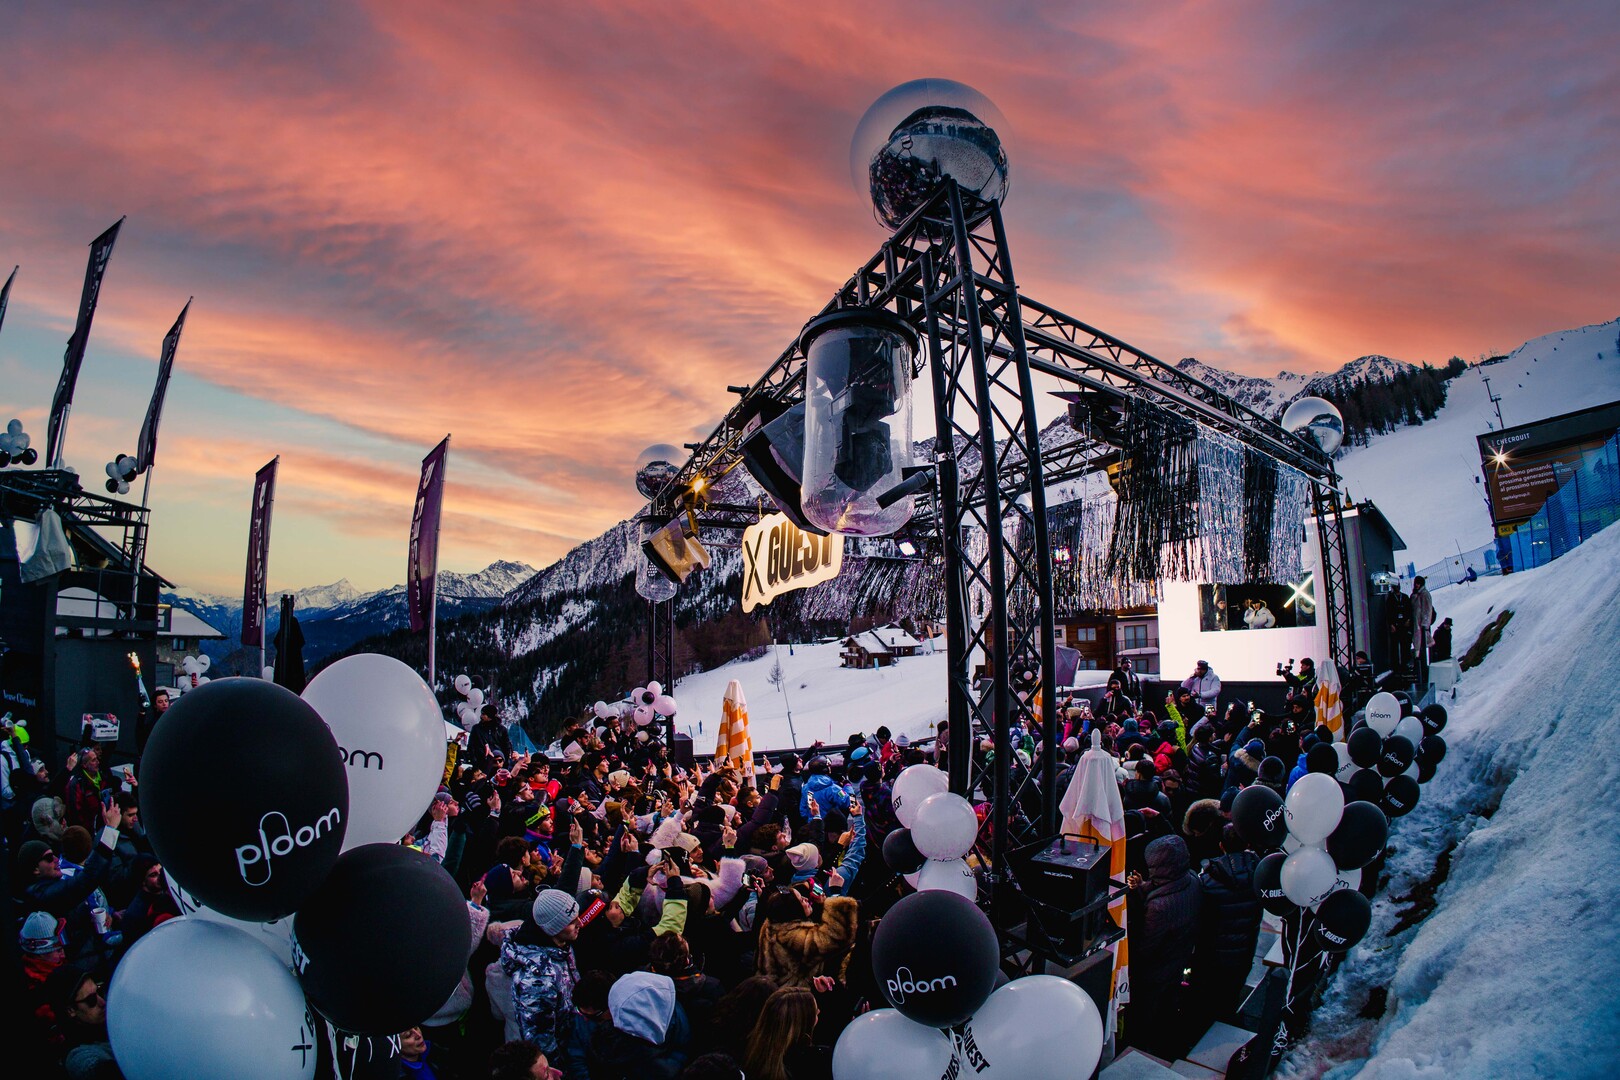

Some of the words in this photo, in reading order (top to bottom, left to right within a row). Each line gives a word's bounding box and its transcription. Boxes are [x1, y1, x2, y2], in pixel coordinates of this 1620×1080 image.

[1496, 432, 1531, 446] CHECROUIT
[1526, 464, 1553, 474] pensando
[1499, 477, 1523, 487] prossima
[1506, 482, 1530, 492] prossimo
[767, 520, 832, 587] GUEST
[1370, 711, 1392, 723] ploom
[1384, 751, 1404, 768] ploom
[1262, 804, 1286, 831] ploom
[235, 807, 341, 887] ploom
[1269, 888, 1286, 899] GUES
[581, 900, 603, 923] upreme
[1324, 930, 1347, 945] GUEST
[886, 966, 957, 1005] ploom
